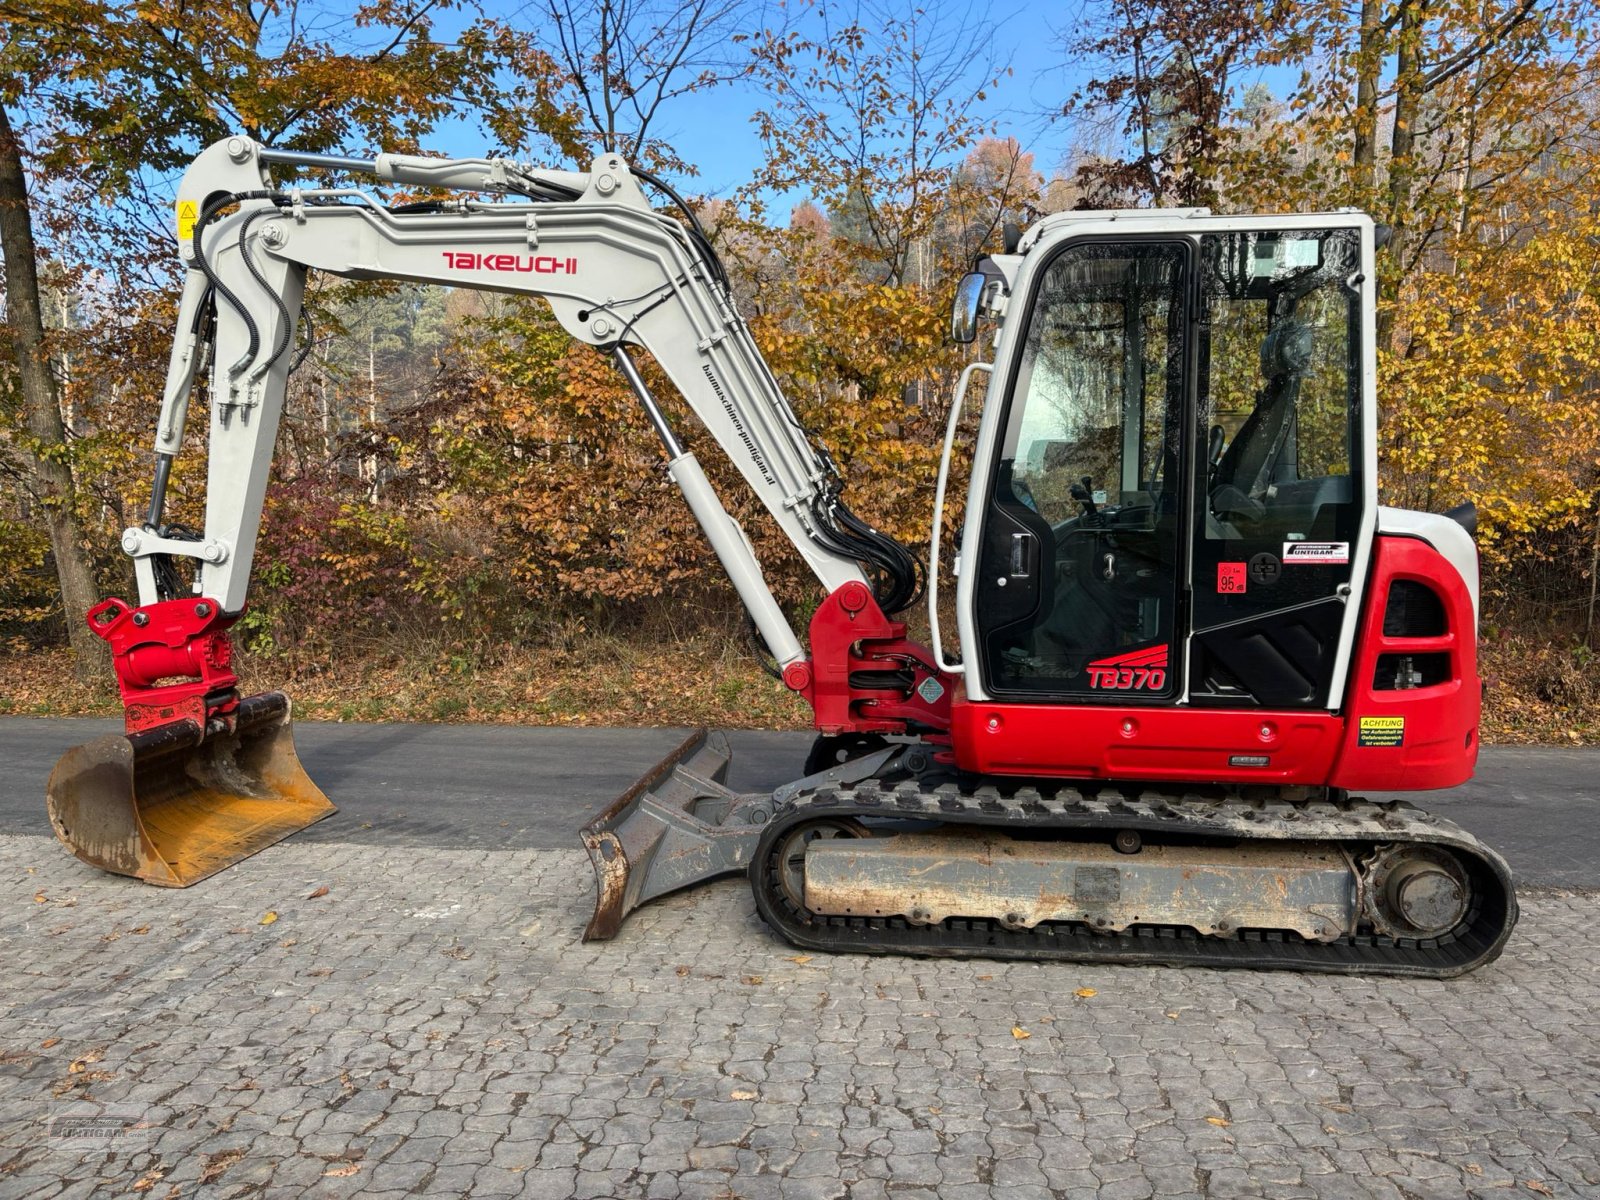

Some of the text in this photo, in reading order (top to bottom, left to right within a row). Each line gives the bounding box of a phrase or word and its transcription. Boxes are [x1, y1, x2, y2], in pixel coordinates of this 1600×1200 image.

[442, 252, 577, 274] TAKEUCHI
[701, 364, 776, 486] baumaschinen-puntigam.at
[1220, 576, 1235, 591] 95
[1085, 667, 1166, 690] TB370
